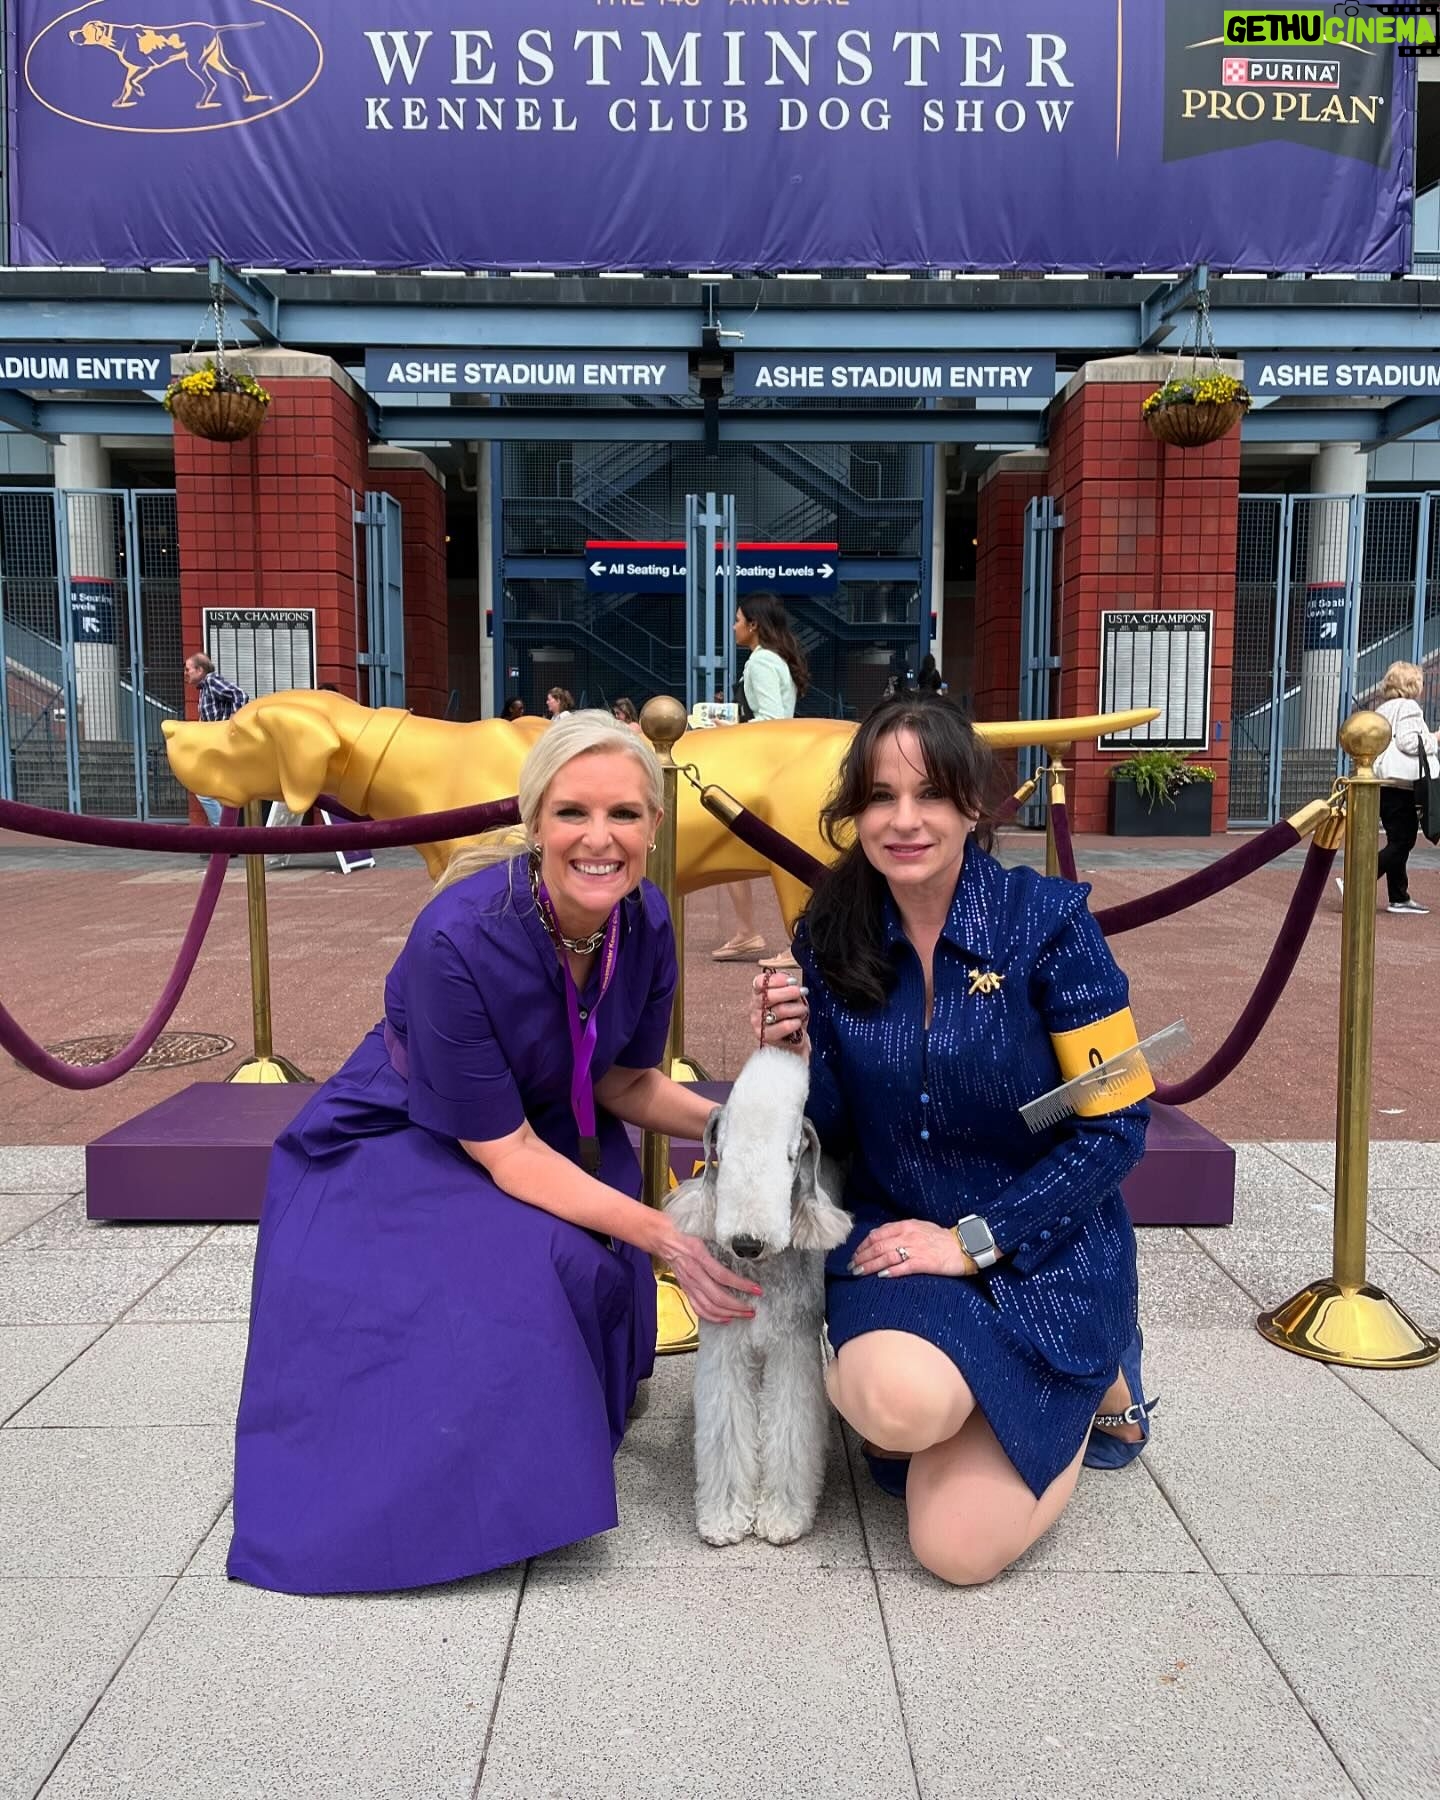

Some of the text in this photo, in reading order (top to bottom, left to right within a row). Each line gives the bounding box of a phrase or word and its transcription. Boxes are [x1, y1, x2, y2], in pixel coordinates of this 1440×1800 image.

[363, 30, 1075, 87] WESTMINSTER
[1251, 63, 1333, 82] PURINA
[365, 98, 1074, 132] KENNEL CLUB DOG SHOW
[1181, 89, 1378, 124] PRO PLAN
[76, 357, 161, 380] ENTRY
[387, 362, 667, 385] ASHE STADIUM ENTRY
[755, 366, 1033, 388] ASHE STADIUM ENTRY
[1258, 364, 1329, 387] ASHE
[609, 564, 625, 575] All
[626, 564, 670, 578] Seating
[778, 565, 815, 577] Levels
[209, 611, 309, 621] USTA CHAMPIONS
[1108, 613, 1207, 624] USTA CHAMPIONS
